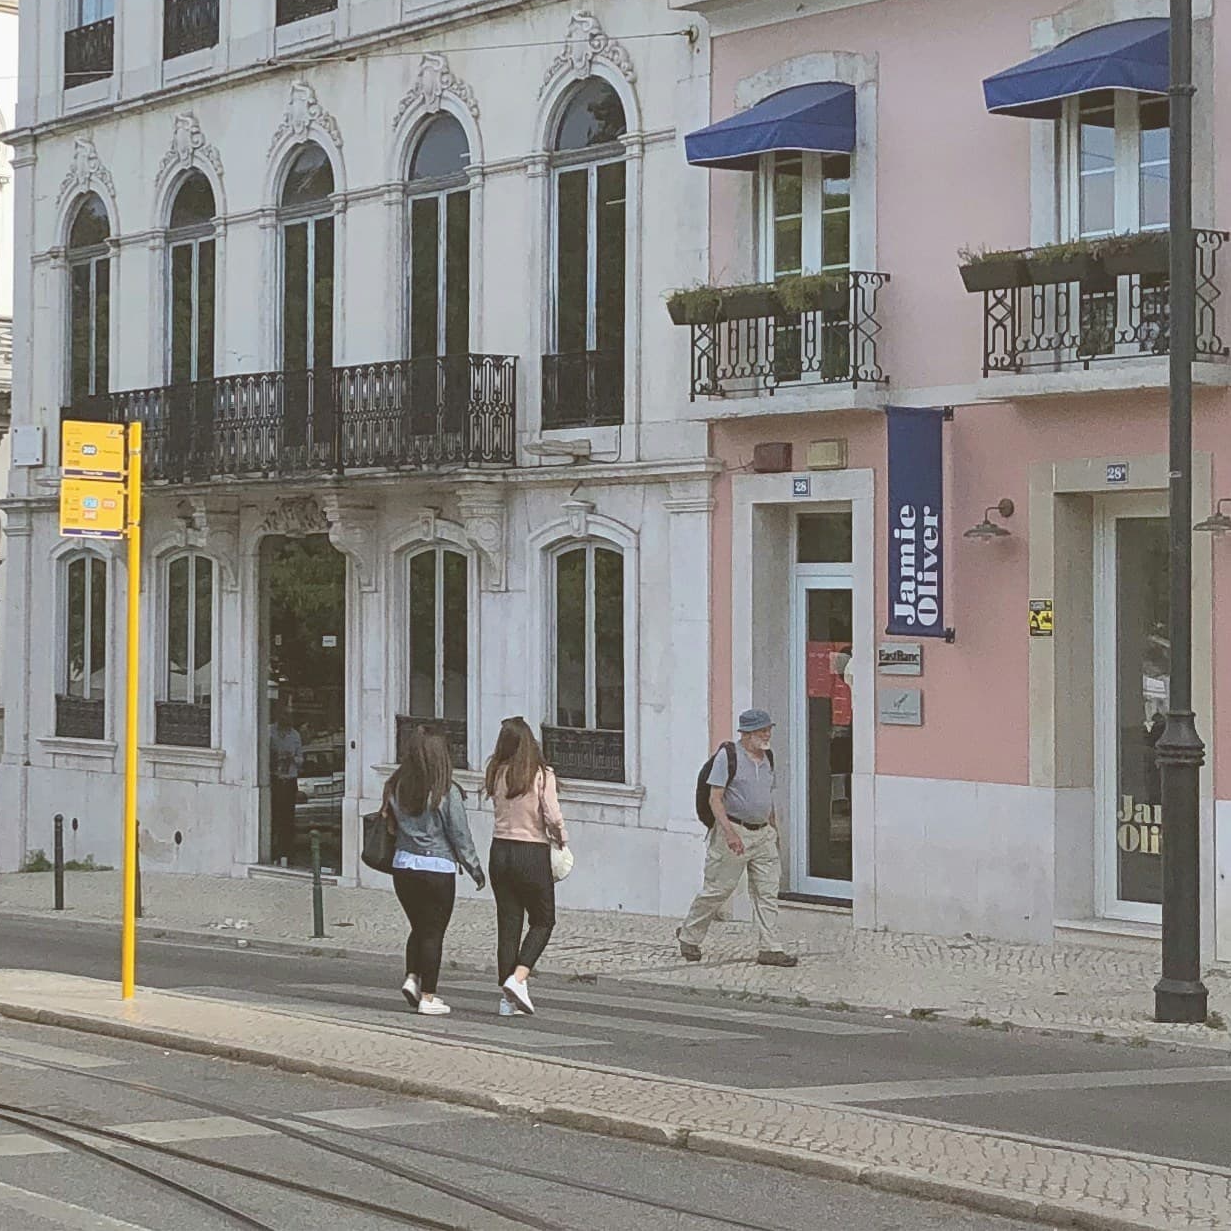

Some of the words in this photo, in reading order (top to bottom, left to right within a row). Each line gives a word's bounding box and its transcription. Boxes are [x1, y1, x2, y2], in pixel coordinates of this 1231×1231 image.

[794, 481, 807, 491] 28
[893, 504, 916, 626] Jamie
[916, 505, 939, 627] Oliver
[1117, 823, 1163, 855] Oli
